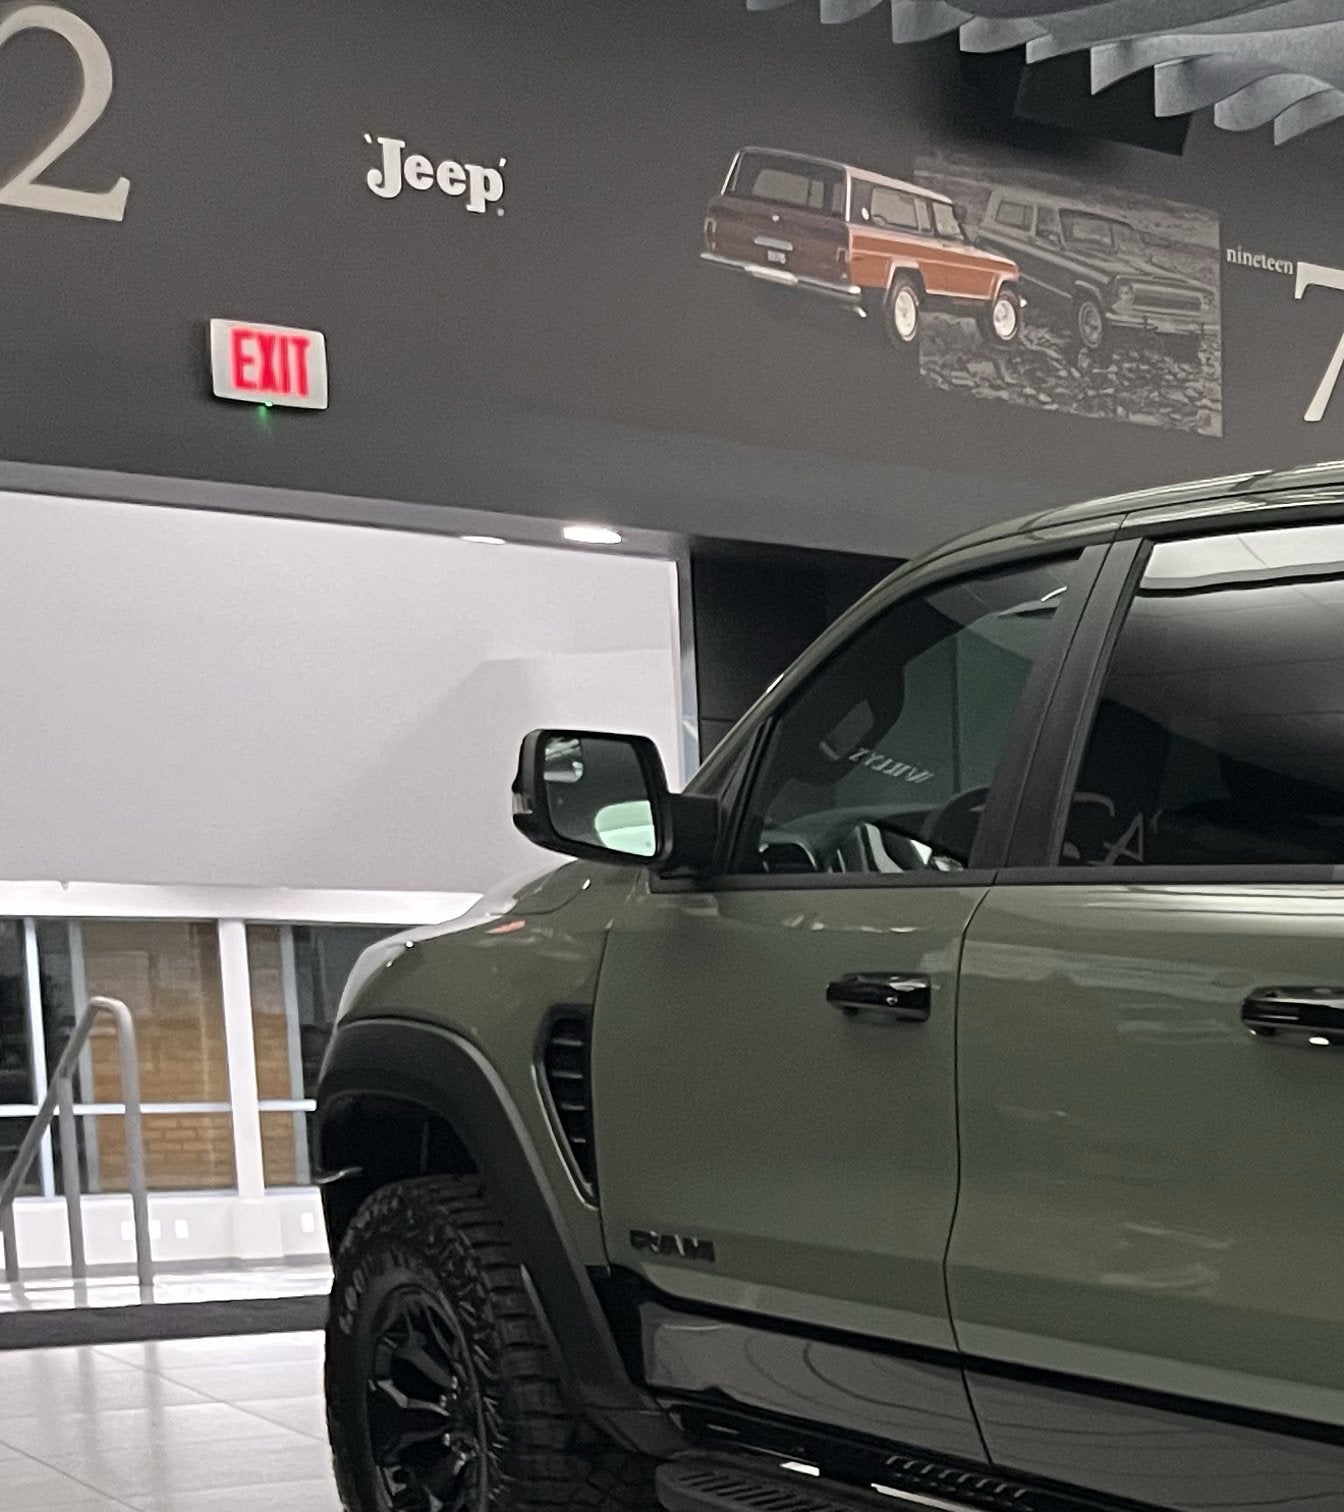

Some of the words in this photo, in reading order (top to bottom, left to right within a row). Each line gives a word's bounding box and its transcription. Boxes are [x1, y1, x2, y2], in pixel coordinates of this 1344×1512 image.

[366, 136, 504, 213] Jeep
[1225, 245, 1294, 275] nineteen
[231, 327, 311, 397] EXIT
[629, 1229, 716, 1263] RAM
